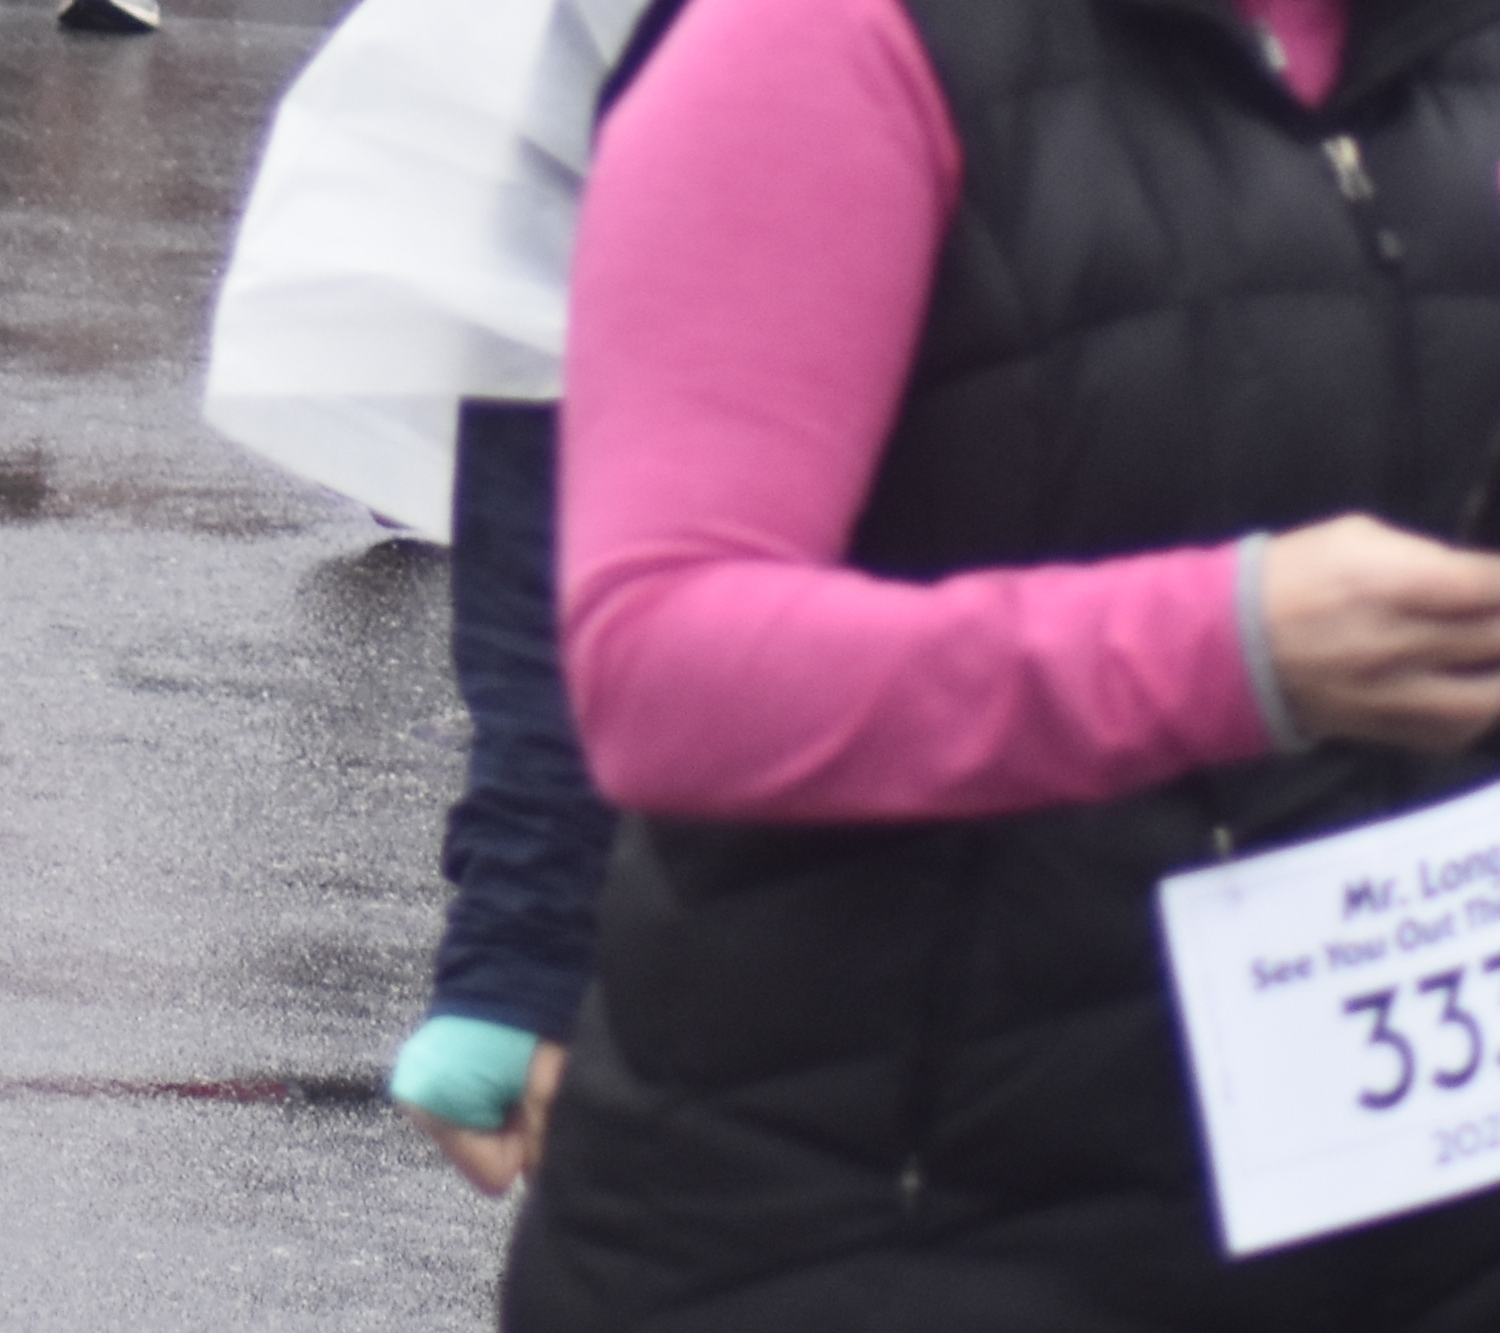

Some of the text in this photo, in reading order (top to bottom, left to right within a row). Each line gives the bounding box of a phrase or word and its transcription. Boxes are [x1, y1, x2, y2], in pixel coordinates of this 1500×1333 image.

[1342, 876, 1410, 923] Mr.
[1250, 953, 1313, 993] See
[1323, 935, 1389, 971] You
[1395, 911, 1457, 953] Out
